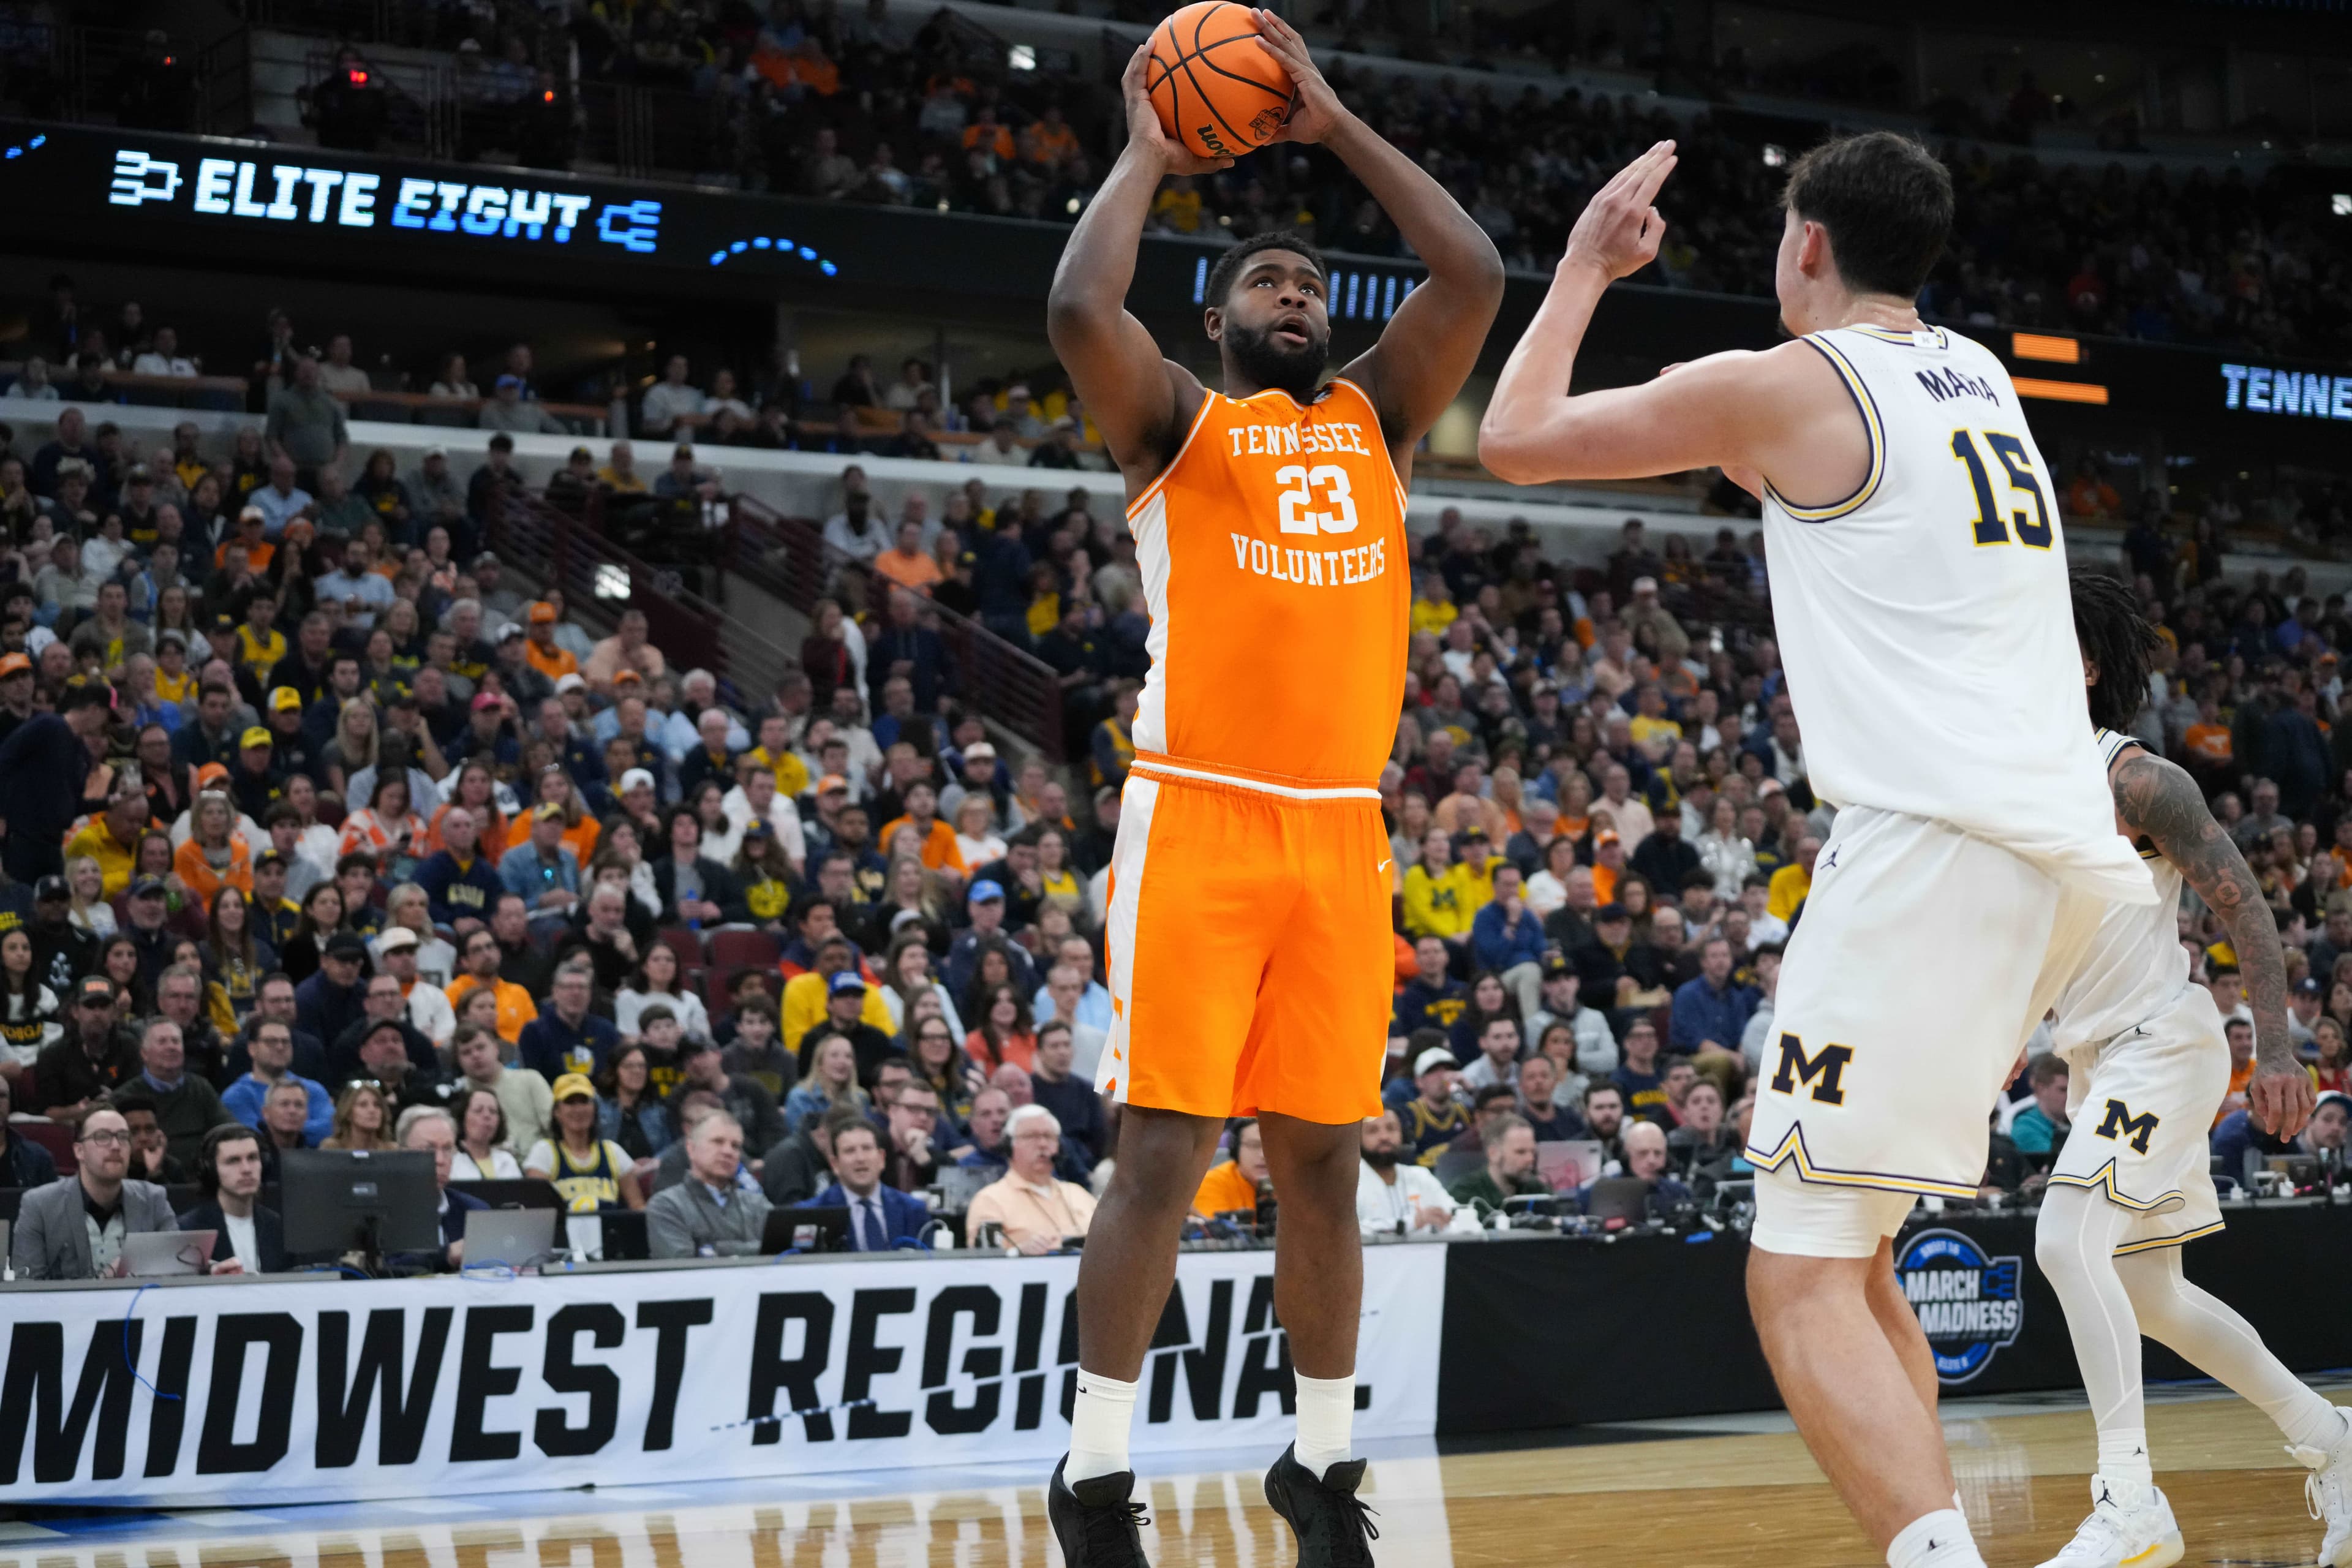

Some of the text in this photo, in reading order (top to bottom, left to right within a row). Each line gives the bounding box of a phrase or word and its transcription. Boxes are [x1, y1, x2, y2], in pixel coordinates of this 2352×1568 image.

[194, 158, 591, 244] ELITE EIGHT
[1915, 366, 2000, 407] MARA
[2220, 363, 2352, 420] TENNE
[1228, 422, 1371, 457] TENNSSEE
[1275, 464, 1358, 536] 23
[1949, 427, 2054, 551] 15
[1231, 532, 1385, 587] VOLUNTEERS
[1771, 1030, 1855, 1107] M
[2095, 1098, 2160, 1156] M
[1905, 1270, 1980, 1301] MARCH
[1918, 1299, 2018, 1333] MADNESS
[0, 1275, 1370, 1486] MIDWEST REGINA
